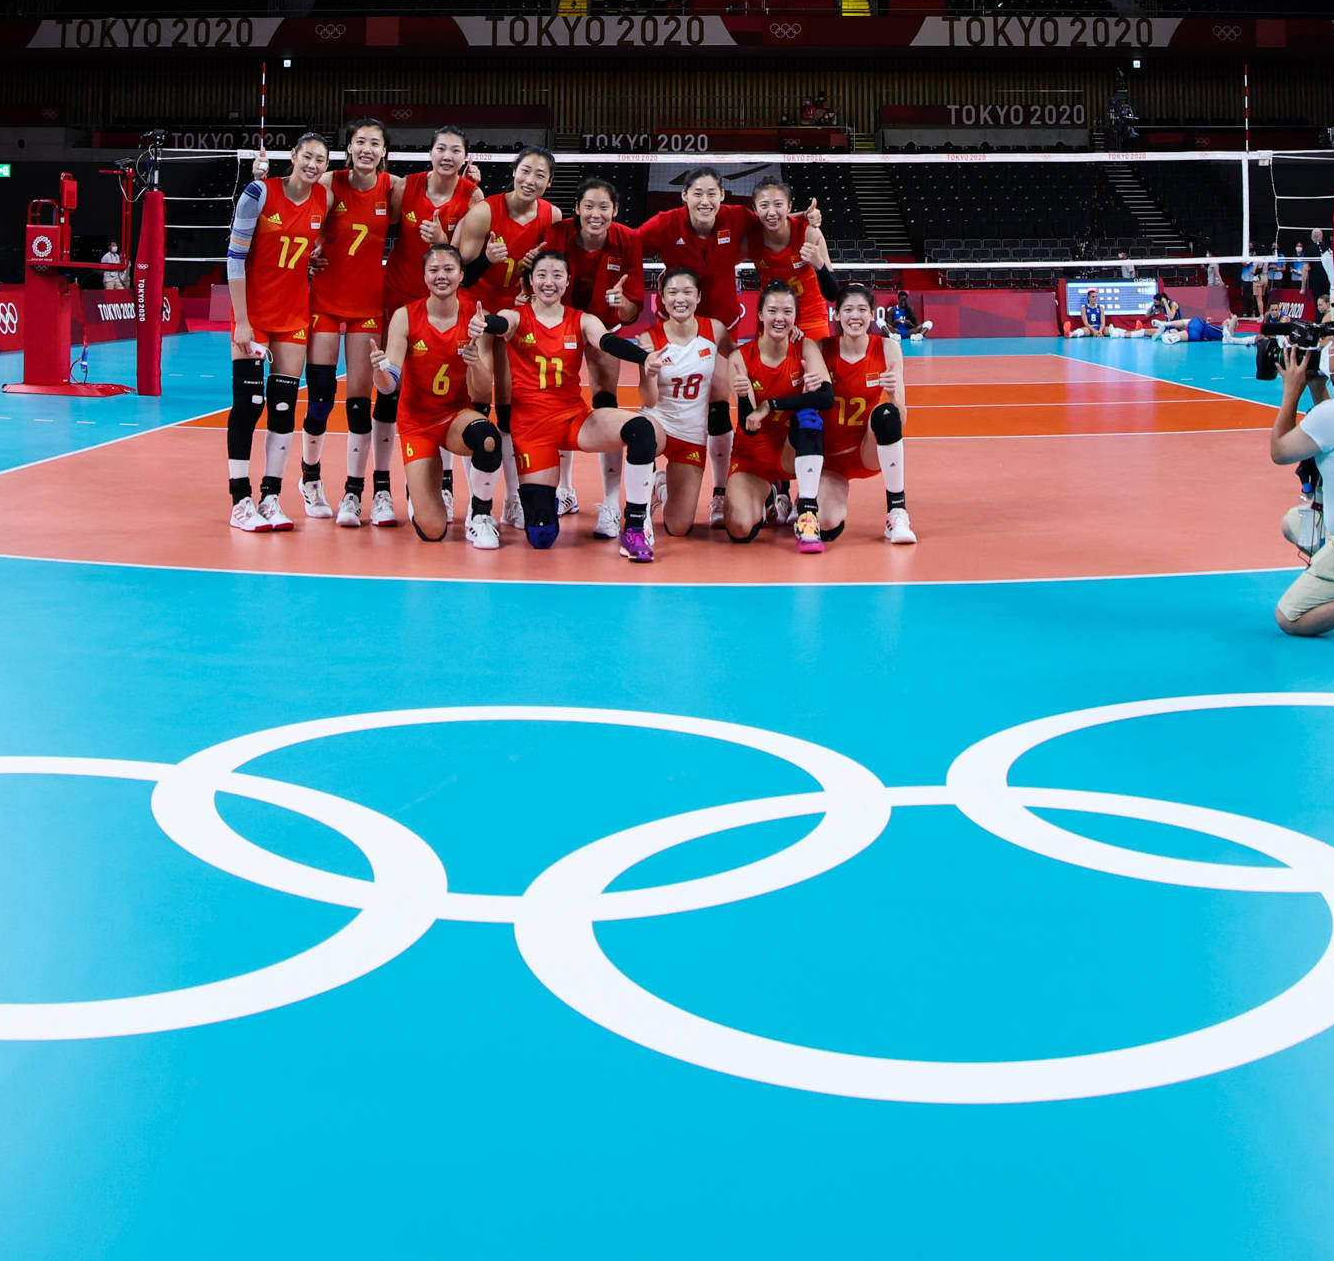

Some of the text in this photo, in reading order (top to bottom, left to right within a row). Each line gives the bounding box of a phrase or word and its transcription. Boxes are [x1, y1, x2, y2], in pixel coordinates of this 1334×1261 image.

[56, 18, 253, 50] TOKYO 2020
[485, 15, 705, 47] TOKYO 2020
[942, 16, 1153, 48] TOKYO 2020
[947, 104, 1086, 125] TOKYO 2020
[172, 132, 287, 150] TOKYO 2020
[582, 133, 709, 152] TOKYO 2020
[278, 235, 309, 269] 17
[348, 223, 369, 257] 7
[97, 302, 136, 321] TOKYO 2020
[137, 279, 146, 322] TOKYO 2020
[1288, 302, 1304, 319] 2020
[312, 314, 320, 328] 7
[1090, 313, 1097, 322] 8
[432, 363, 450, 396] 6
[535, 355, 563, 389] 11
[671, 373, 704, 400] 18
[834, 396, 867, 426] 12
[405, 442, 414, 457] 6
[518, 453, 531, 469] 11
